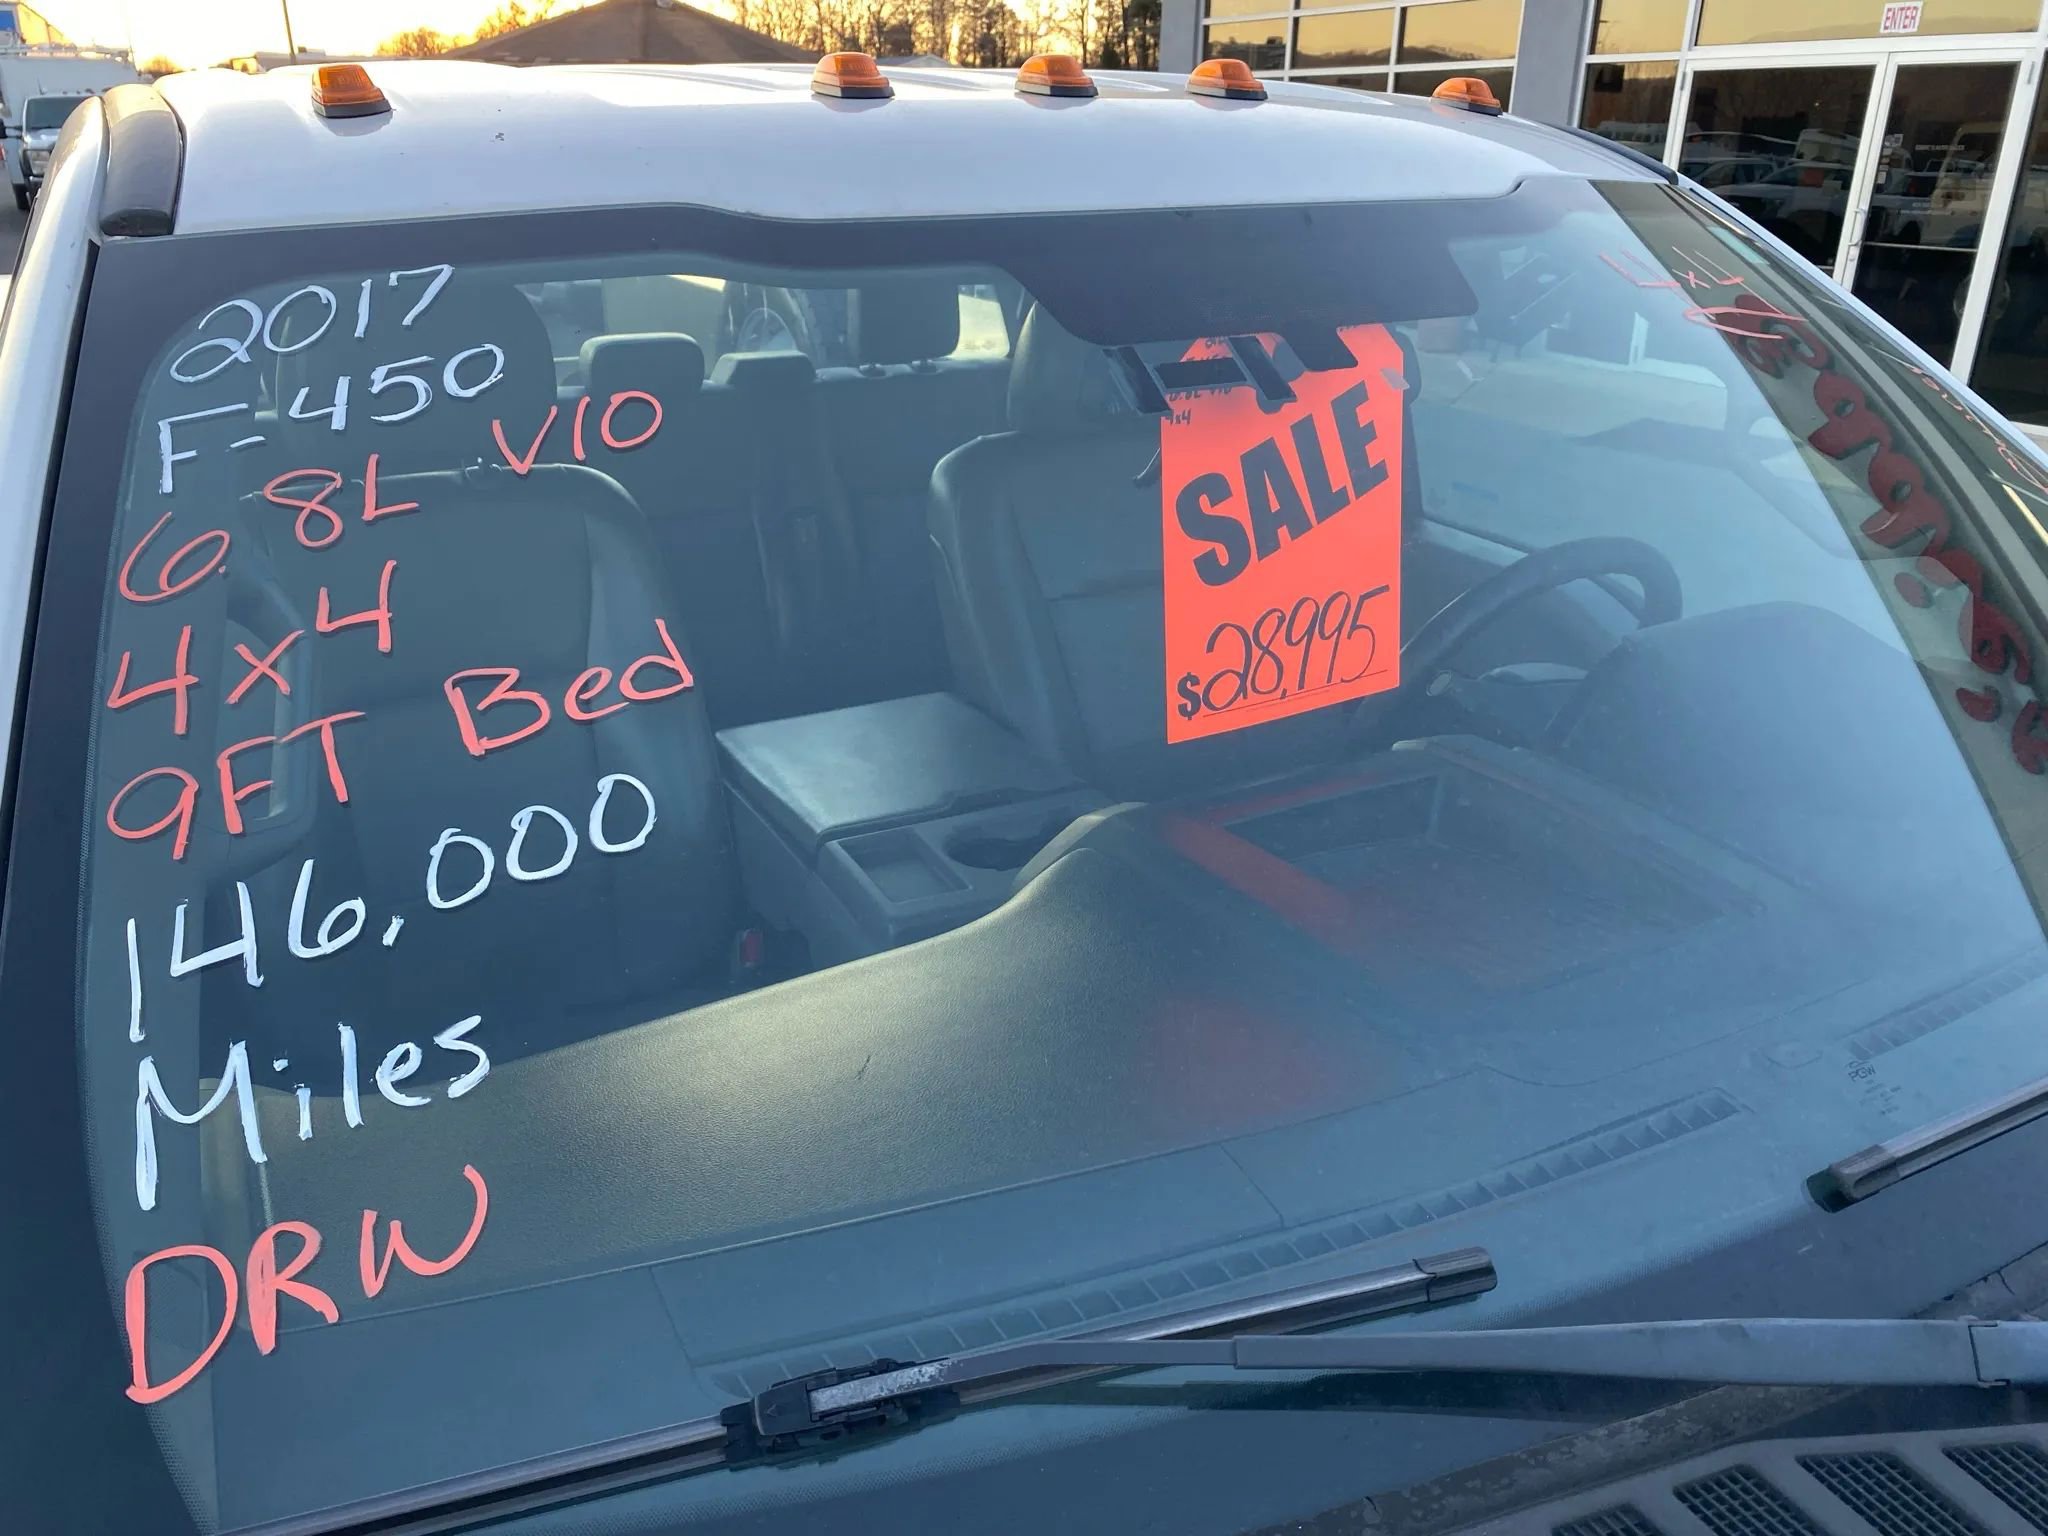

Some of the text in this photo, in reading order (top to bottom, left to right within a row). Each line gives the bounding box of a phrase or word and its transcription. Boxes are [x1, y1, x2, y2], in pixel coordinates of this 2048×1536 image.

[1883, 6, 1919, 30] ENTER
[170, 263, 456, 383] 2017
[118, 390, 663, 602] 6.8L V10
[157, 343, 505, 495] F-450
[1176, 380, 1389, 587] SALE
[443, 617, 694, 756] Bed
[1177, 585, 1390, 721] $28,995
[128, 772, 657, 1043] 146,000
[135, 1015, 492, 1211] Miles
[125, 1163, 489, 1405] DRW
